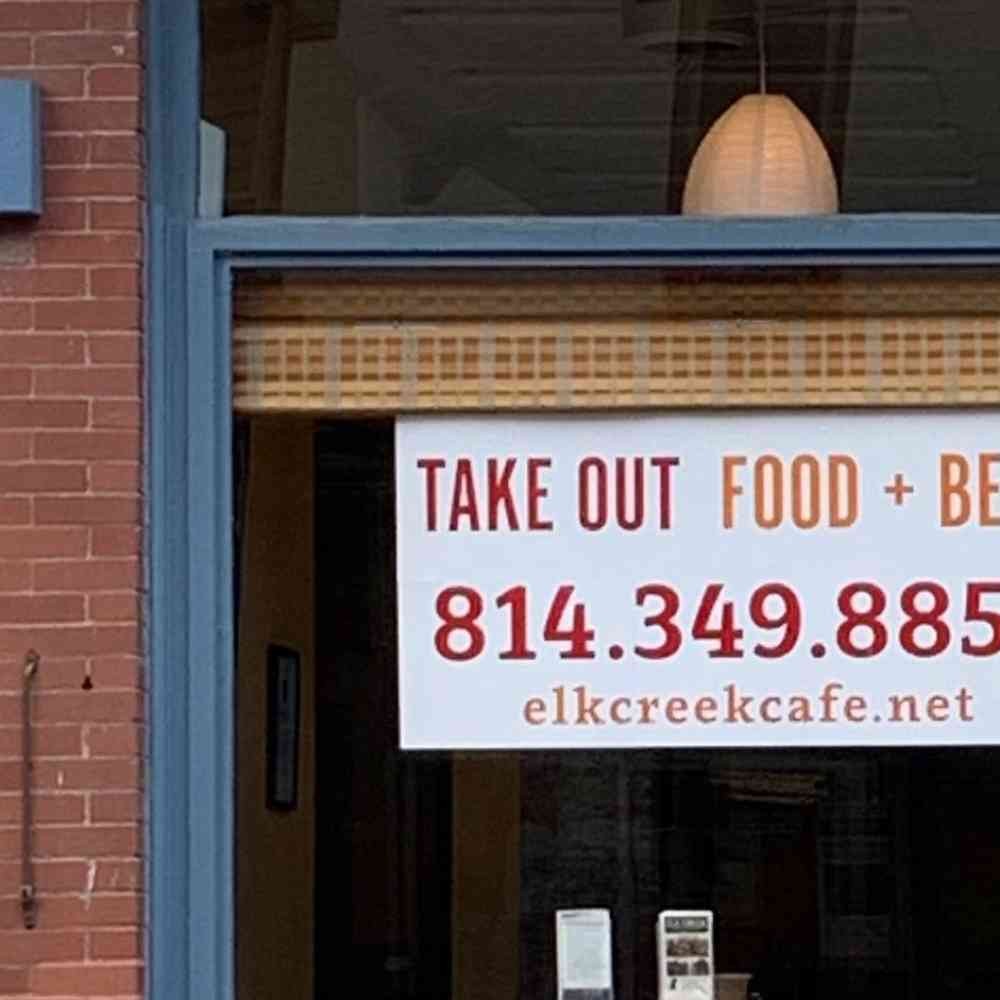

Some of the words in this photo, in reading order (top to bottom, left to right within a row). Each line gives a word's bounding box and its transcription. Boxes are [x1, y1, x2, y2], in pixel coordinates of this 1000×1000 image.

[417, 457, 554, 531] TAKE
[577, 456, 680, 531] OUT
[720, 454, 858, 529] FOOD
[884, 474, 914, 505] +
[523, 683, 974, 725] elkcreekcafe.net
